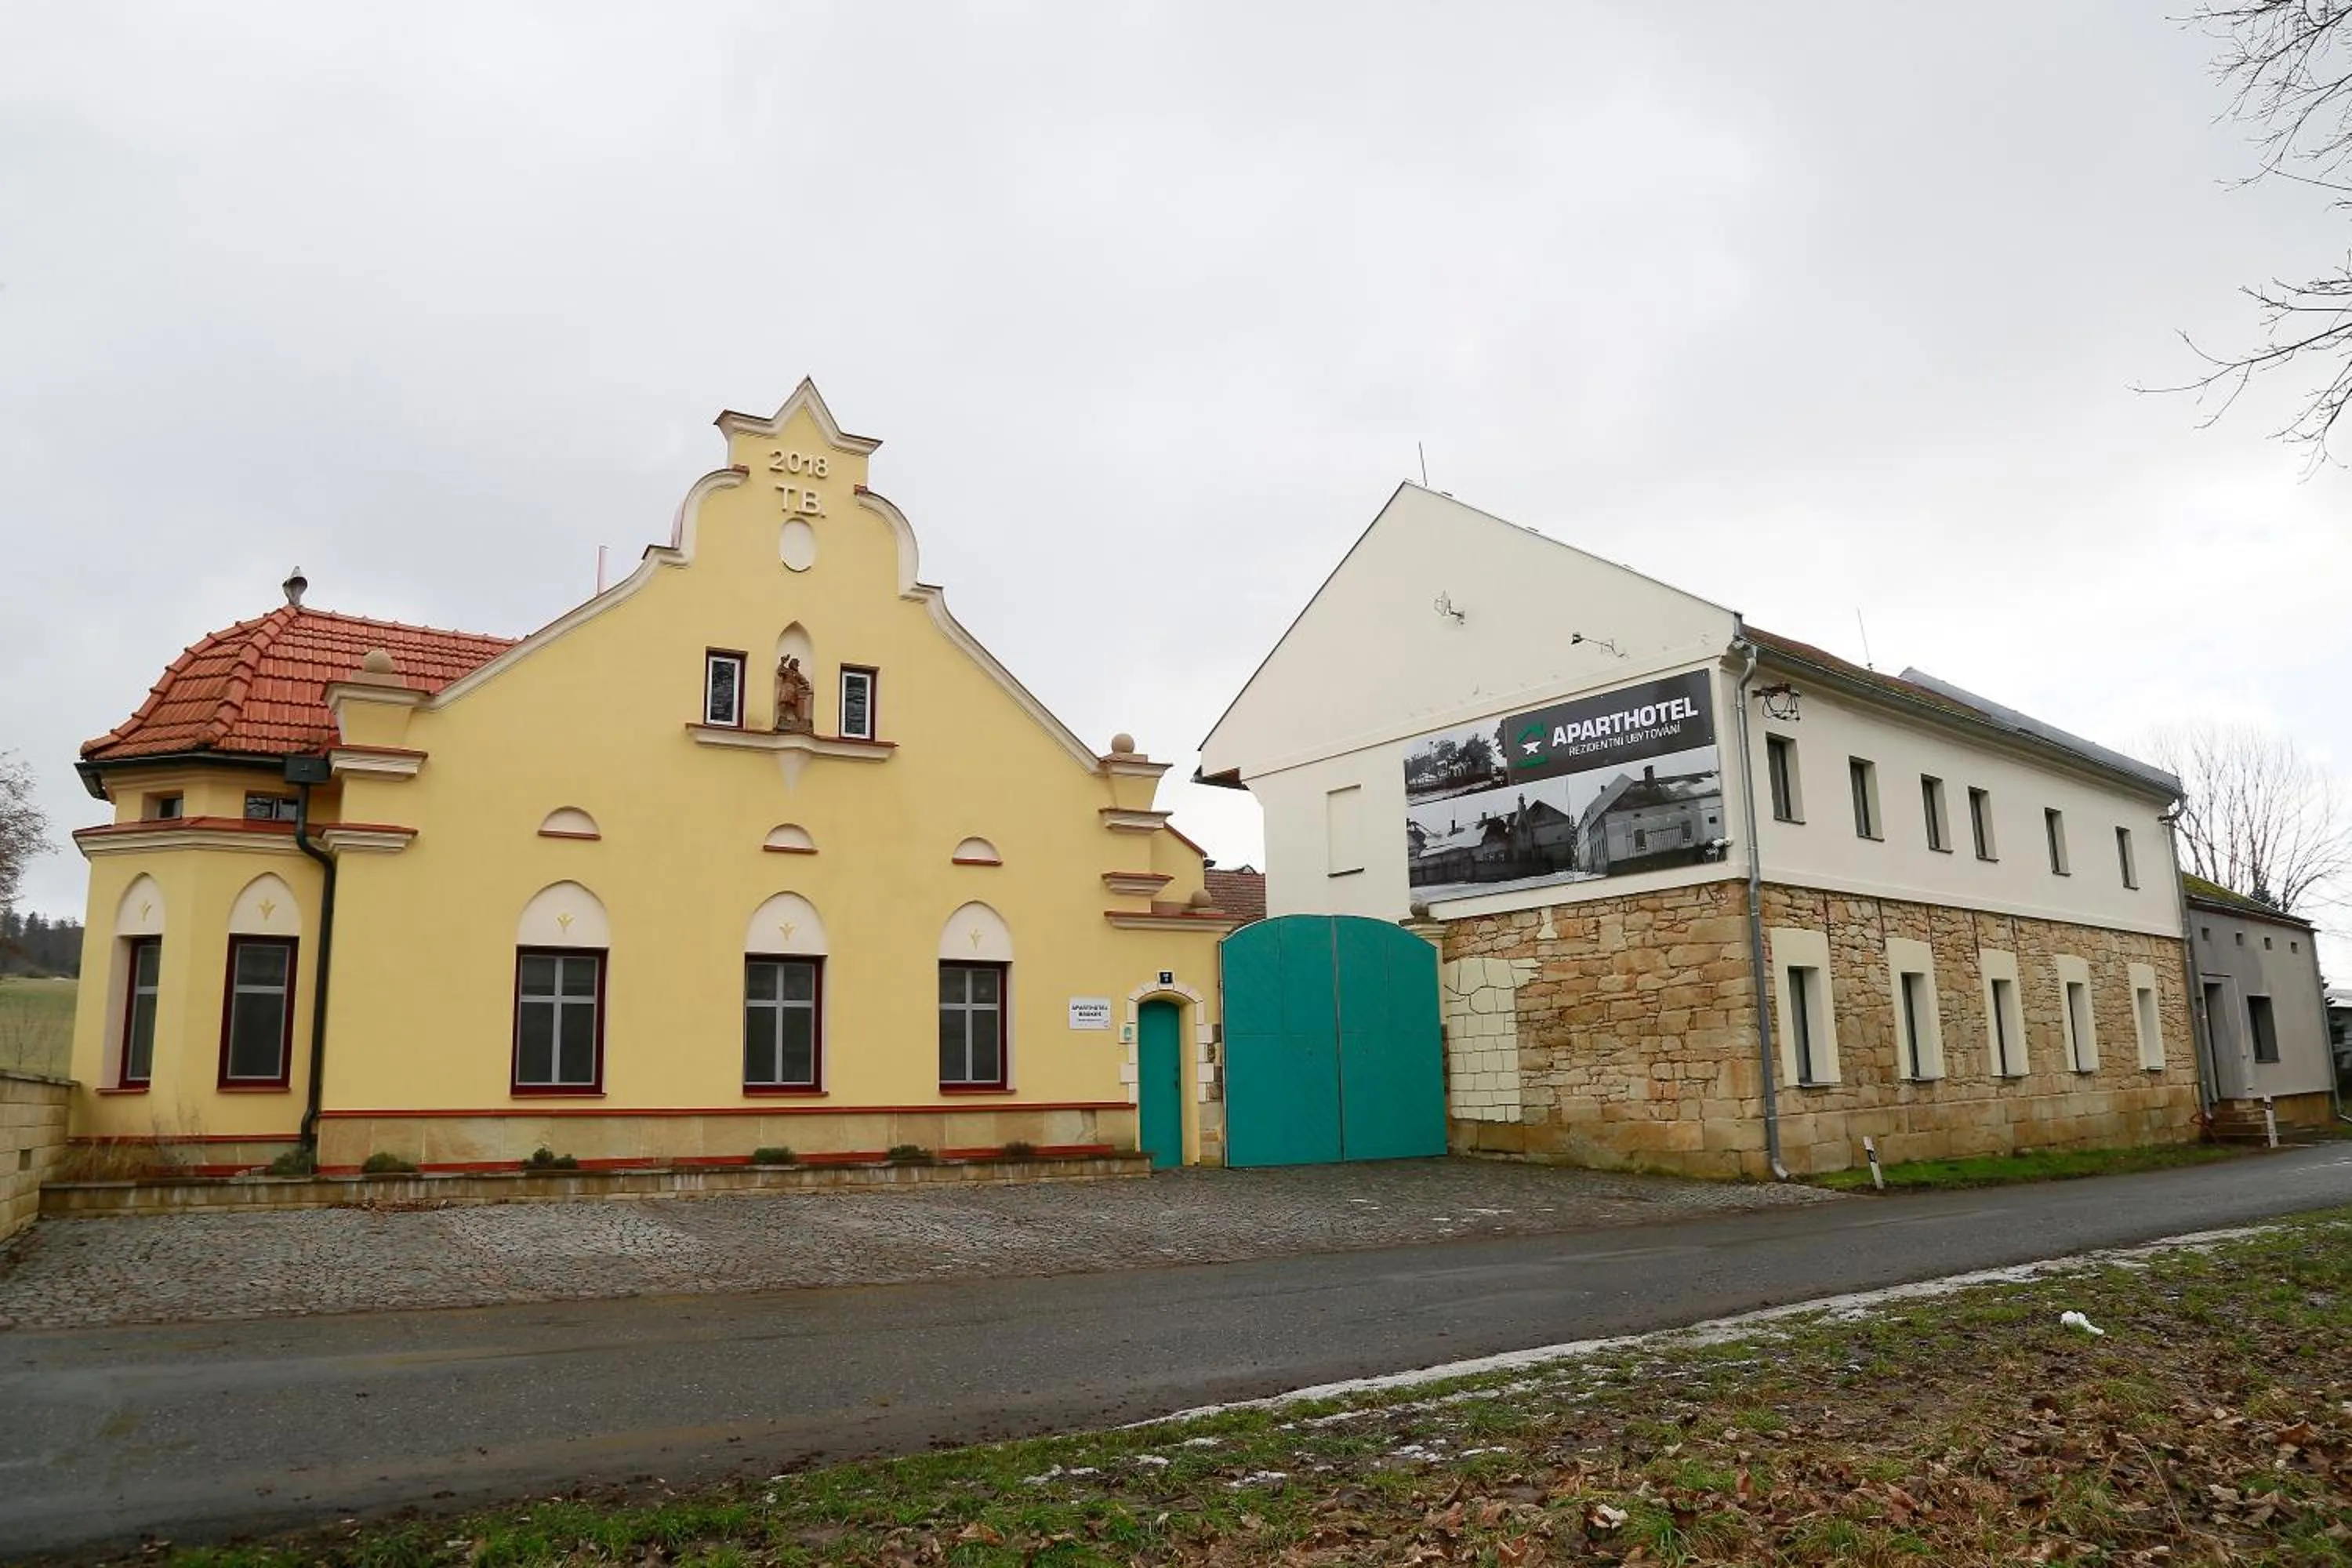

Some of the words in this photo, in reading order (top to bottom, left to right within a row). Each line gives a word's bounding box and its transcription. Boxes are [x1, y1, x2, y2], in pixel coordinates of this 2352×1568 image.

[769, 449, 829, 478] 2018
[1552, 697, 1699, 747] APARTHOTEL
[1626, 721, 1681, 744] UBYTOVÁNÍ
